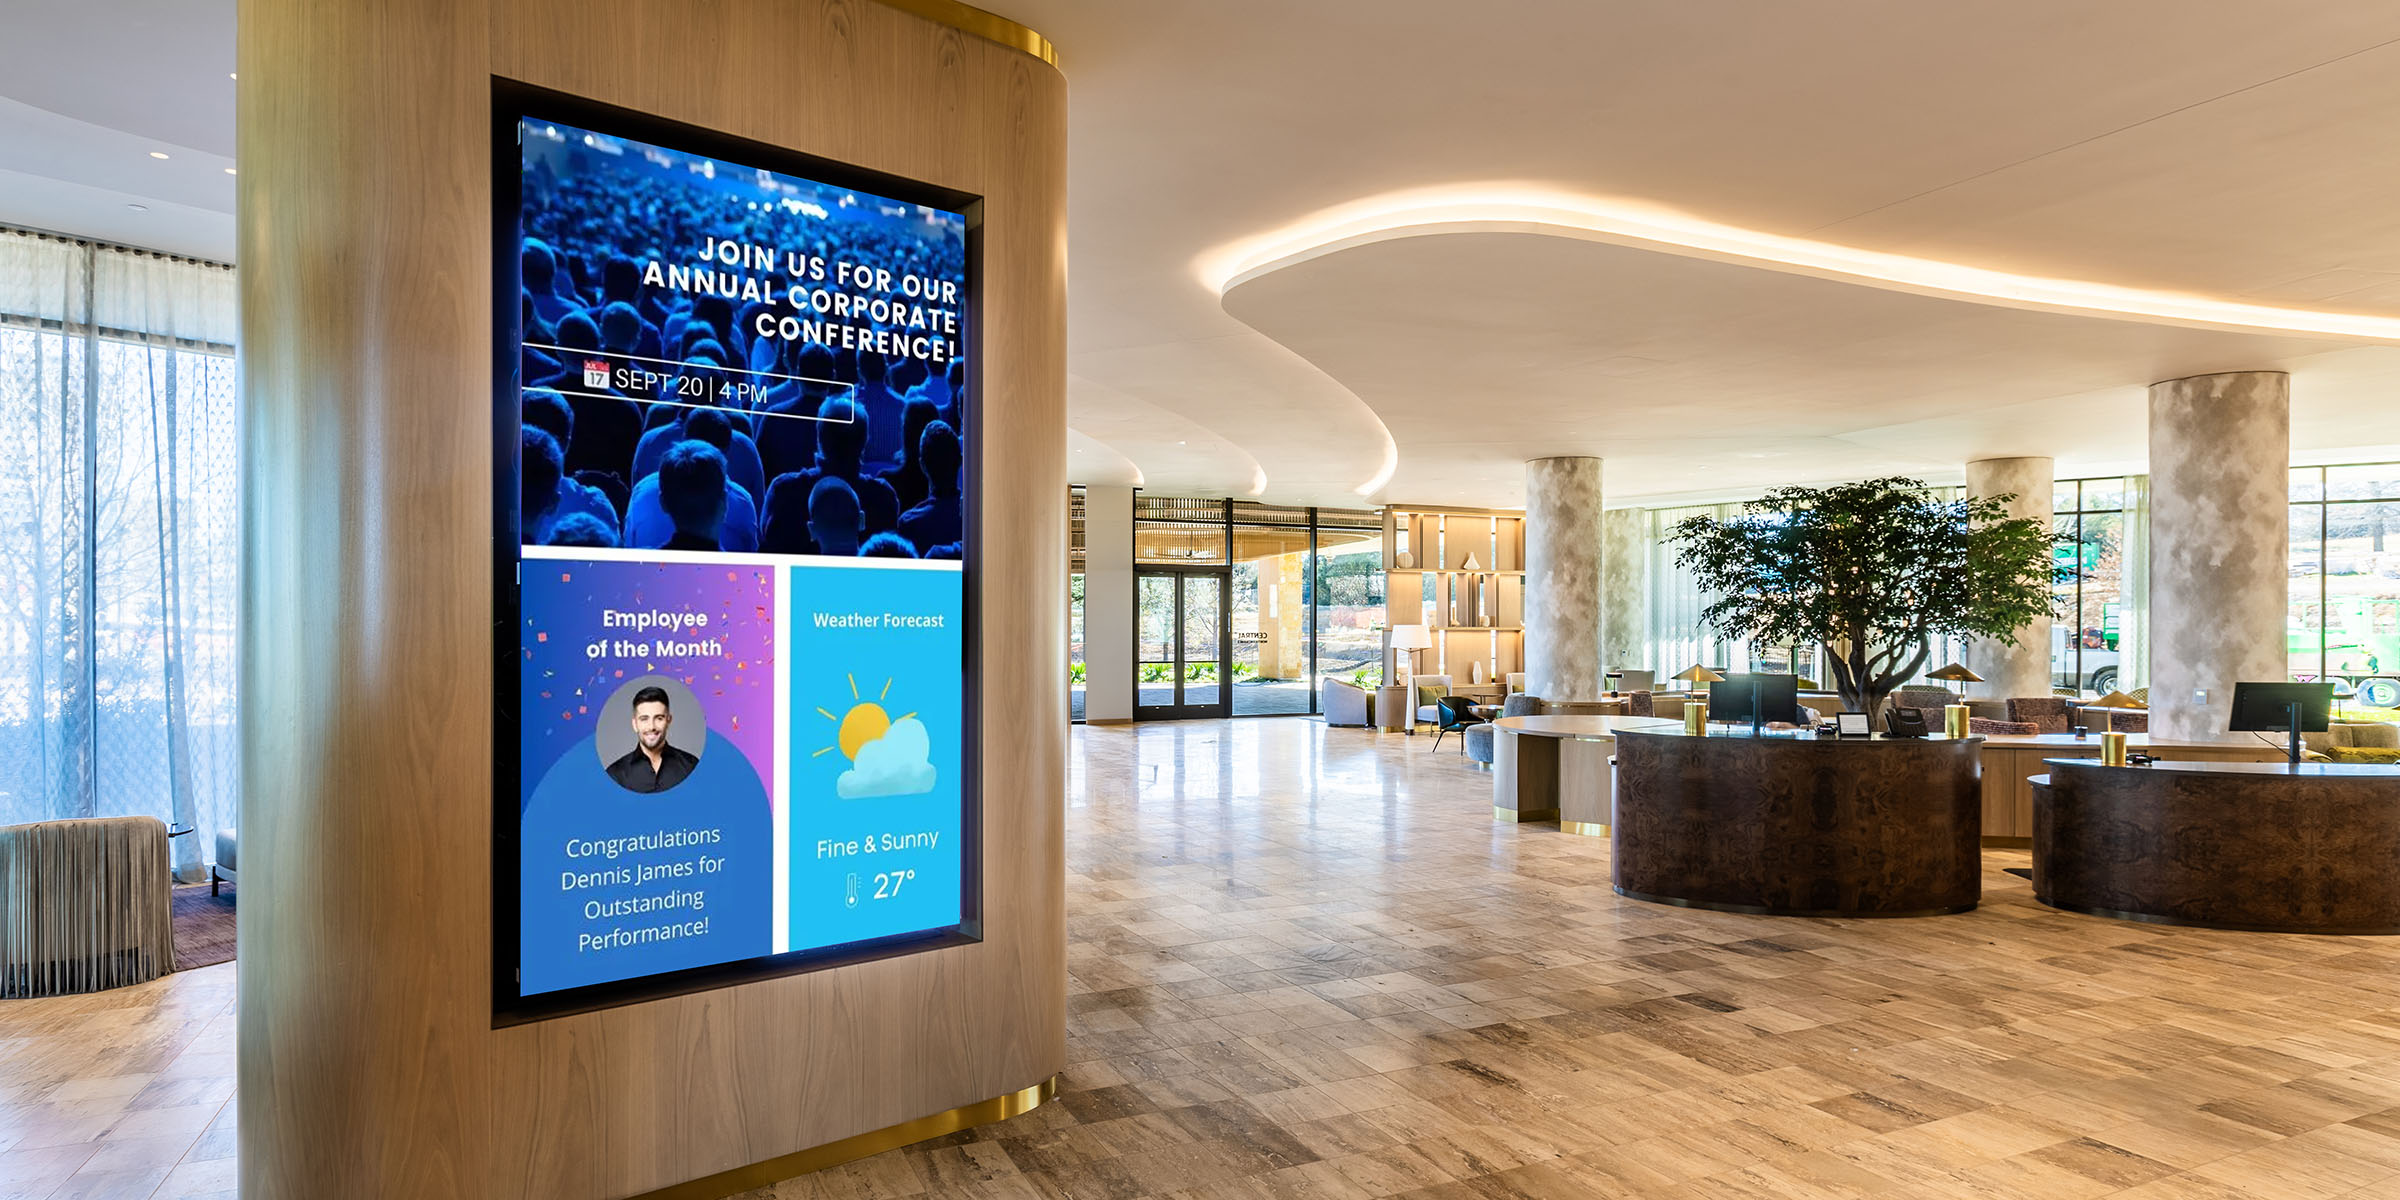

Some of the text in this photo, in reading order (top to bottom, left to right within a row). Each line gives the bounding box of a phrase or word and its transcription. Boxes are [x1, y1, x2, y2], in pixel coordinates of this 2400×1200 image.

[697, 236, 957, 305] JOIN US FOR OUR
[643, 260, 957, 335] ANNUAL CORPORATE
[755, 312, 956, 364] CONFERENCE!
[590, 371, 604, 386] 17
[615, 368, 672, 392] SEPT
[677, 375, 703, 397] 20
[718, 381, 731, 399] 4
[737, 382, 767, 404] PM
[603, 608, 709, 632] Employee
[814, 612, 944, 628] Weather Forecast
[586, 639, 722, 659] of the Month
[566, 828, 721, 859] Congratulations
[817, 831, 939, 859] Fine & Sunny
[562, 855, 725, 890] Dennis James for
[584, 889, 705, 920] Outstanding
[579, 916, 709, 952] Performance!
